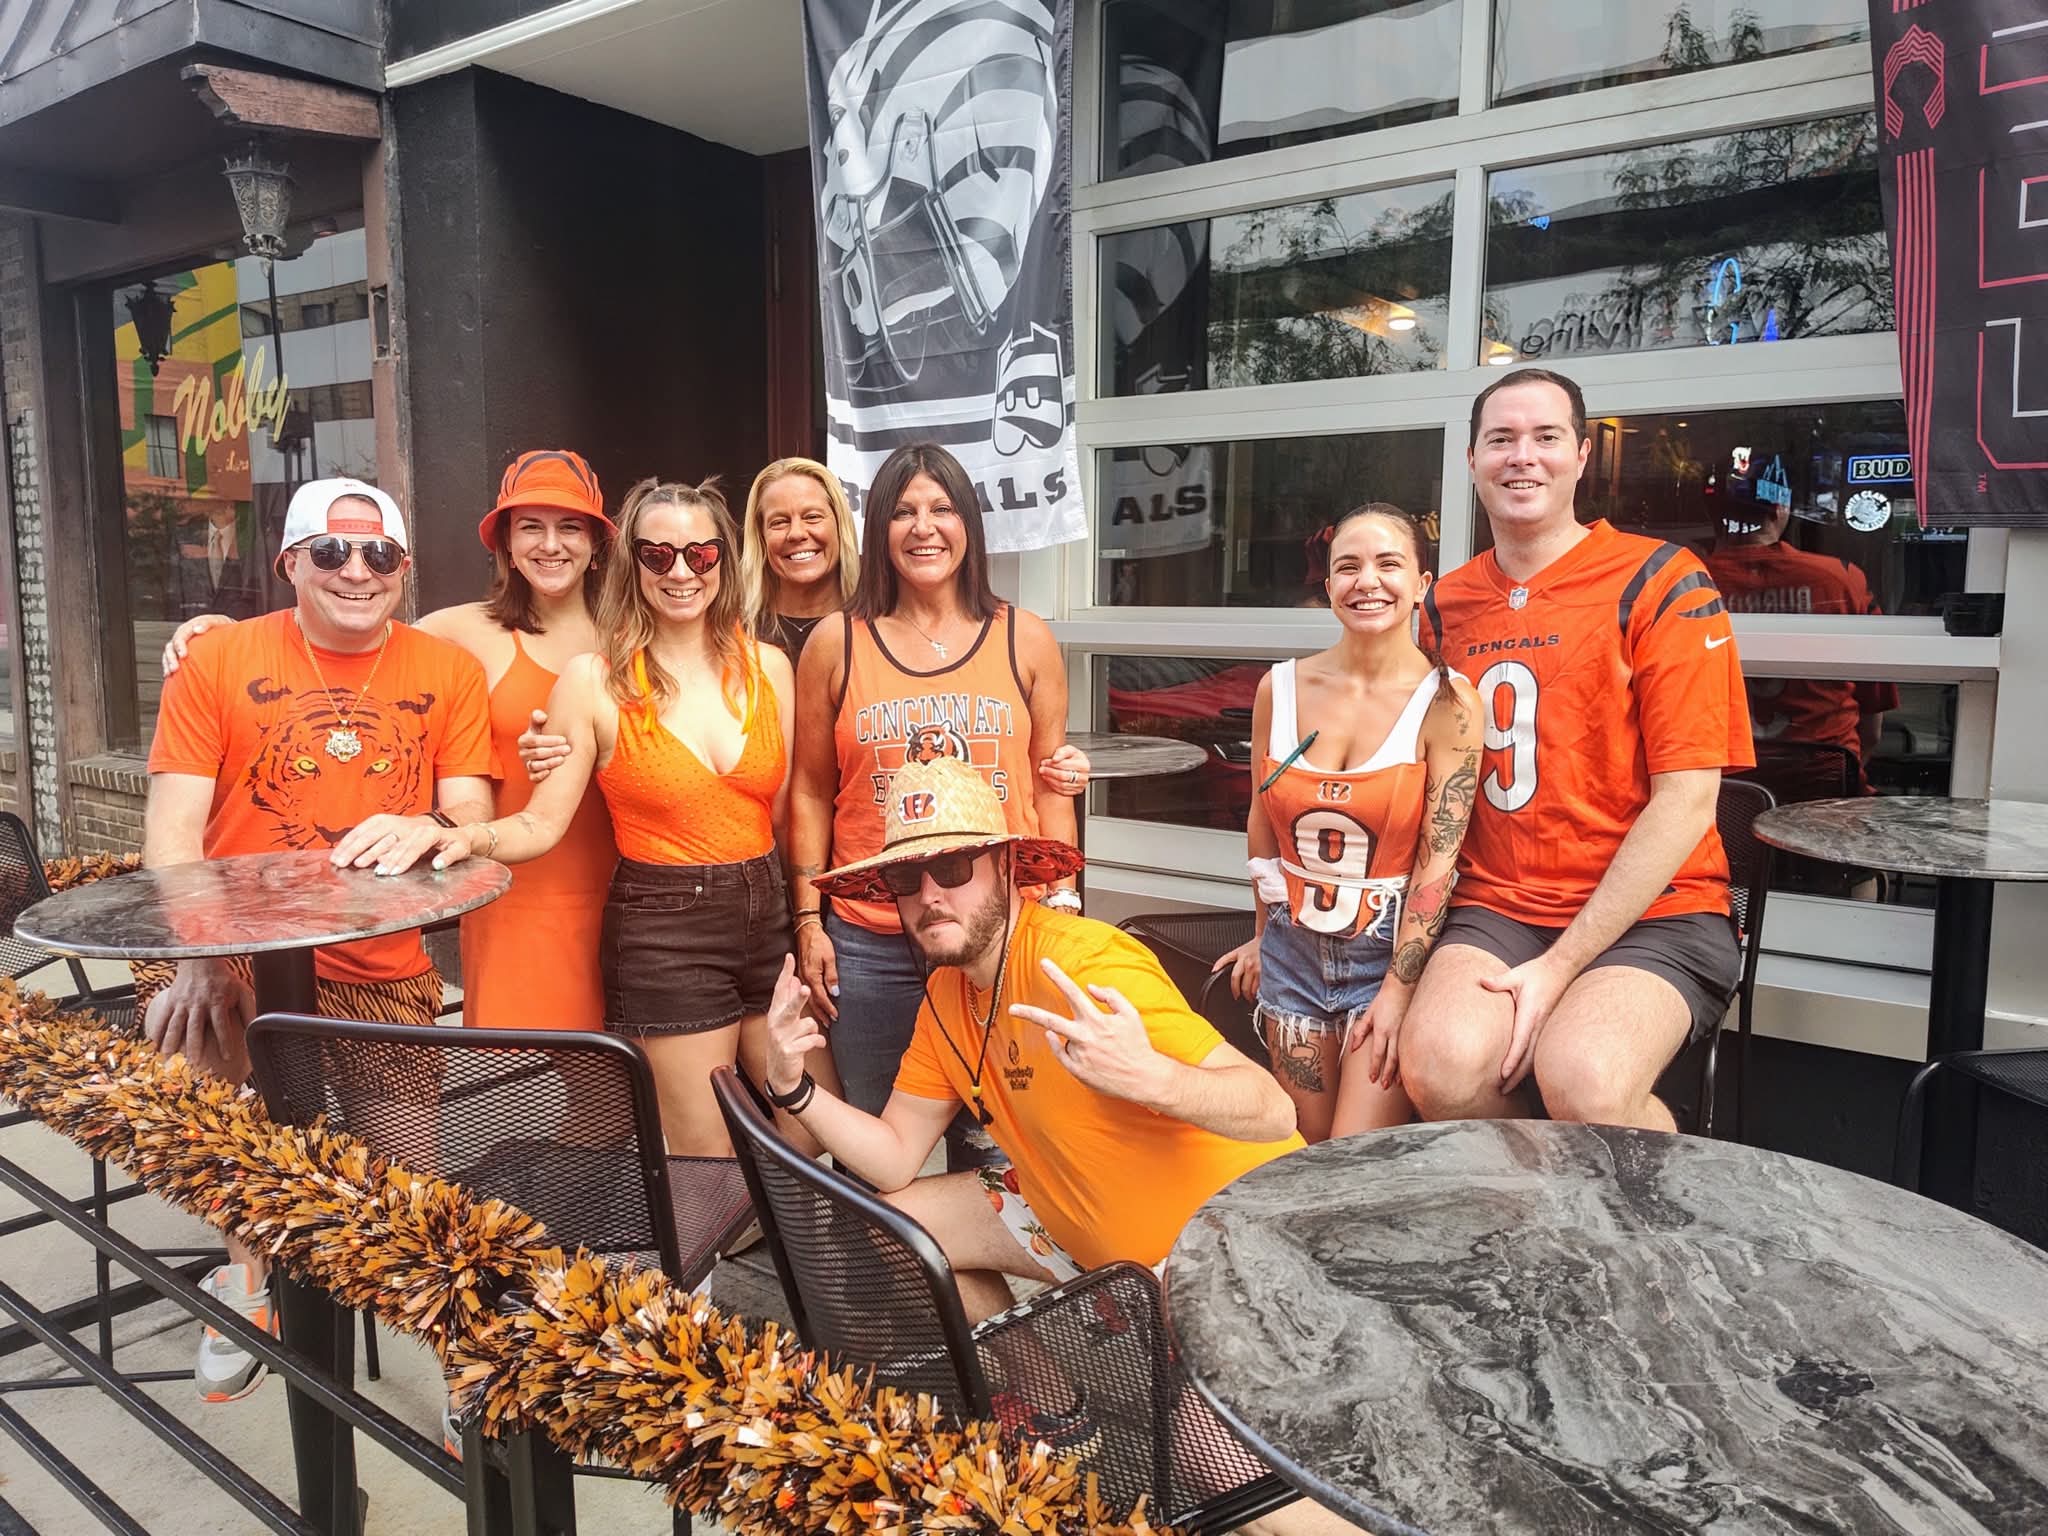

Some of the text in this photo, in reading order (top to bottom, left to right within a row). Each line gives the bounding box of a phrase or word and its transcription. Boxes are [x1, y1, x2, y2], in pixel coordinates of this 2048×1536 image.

[1853, 458, 1911, 479] BUD
[1466, 634, 1560, 657] BENGALS
[855, 693, 1014, 744] CINCINNATI
[1477, 660, 1540, 813] 9
[1290, 807, 1379, 936] 9
